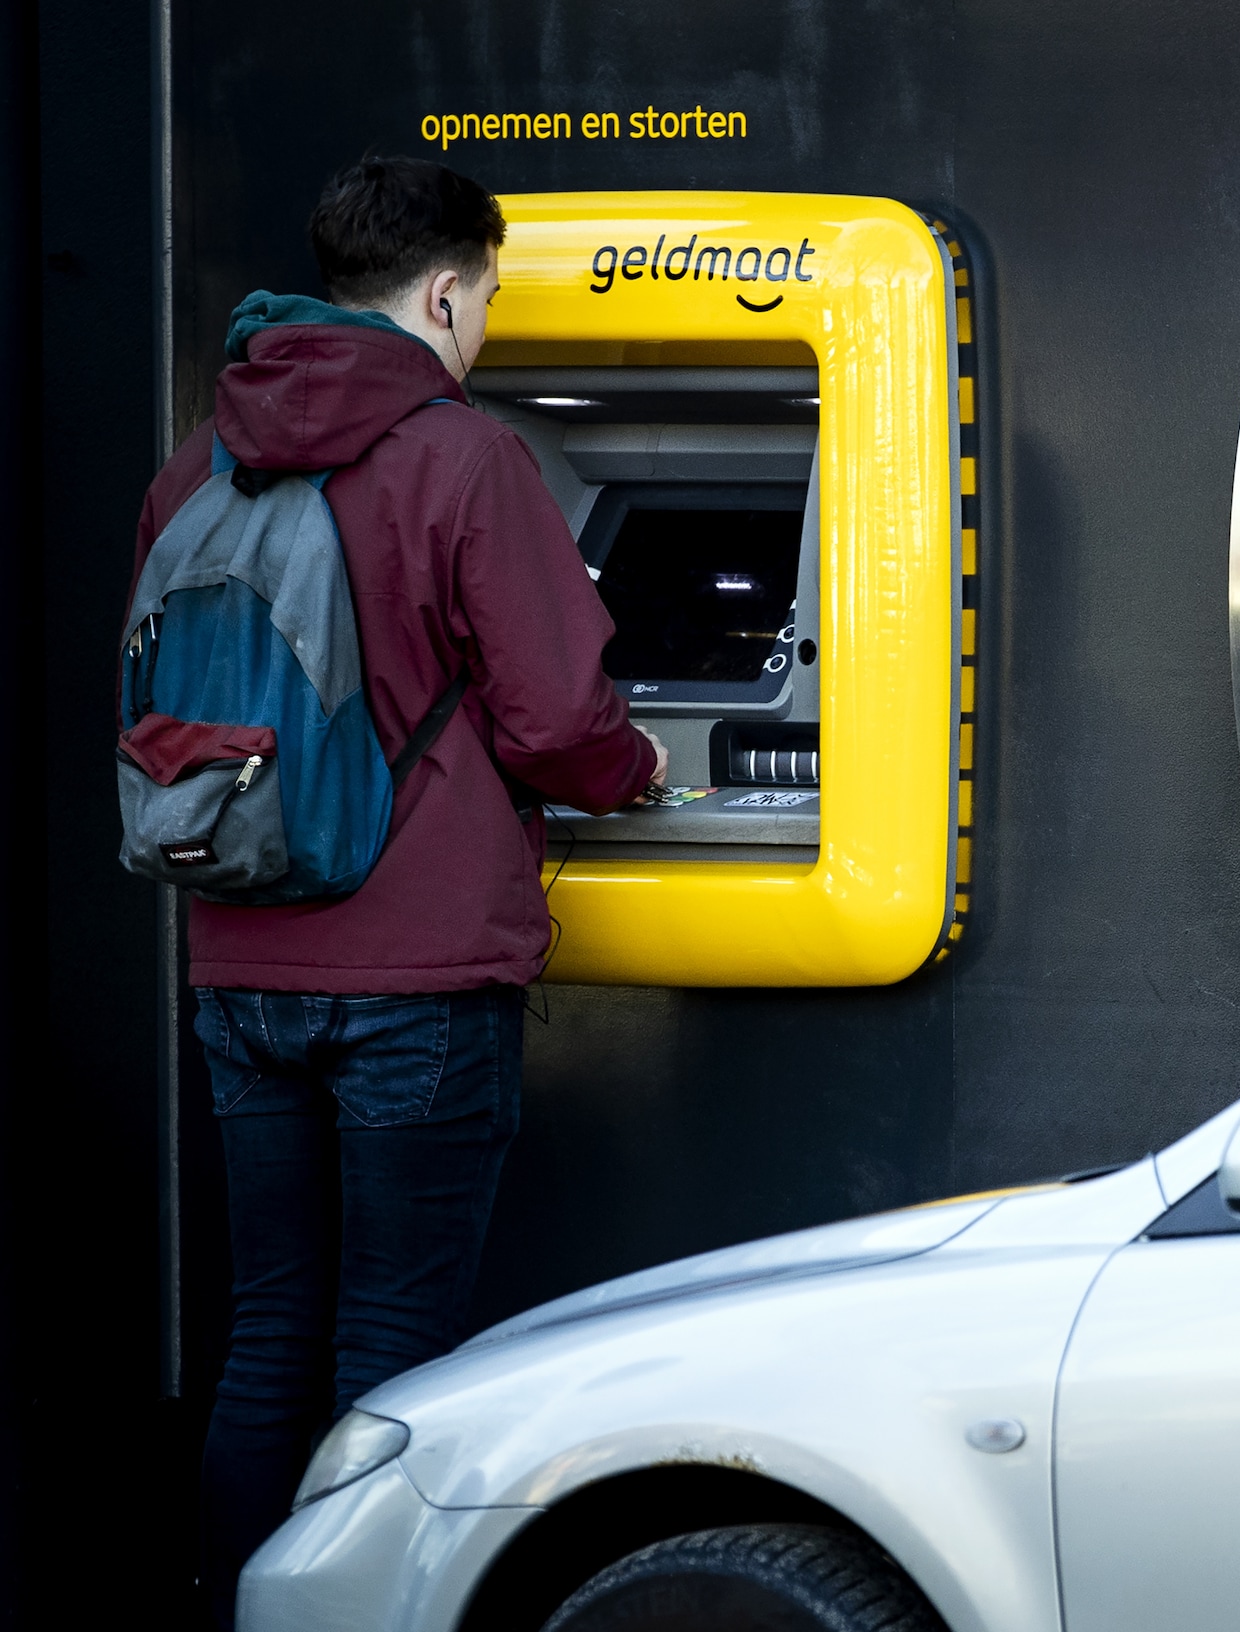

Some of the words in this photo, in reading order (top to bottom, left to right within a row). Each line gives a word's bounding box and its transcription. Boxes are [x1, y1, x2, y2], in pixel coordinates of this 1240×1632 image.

[421, 111, 572, 151] opnemen
[581, 111, 620, 139] en
[629, 104, 747, 139] storten
[589, 234, 816, 294] geldmaat
[169, 849, 207, 860] EASTPAK
